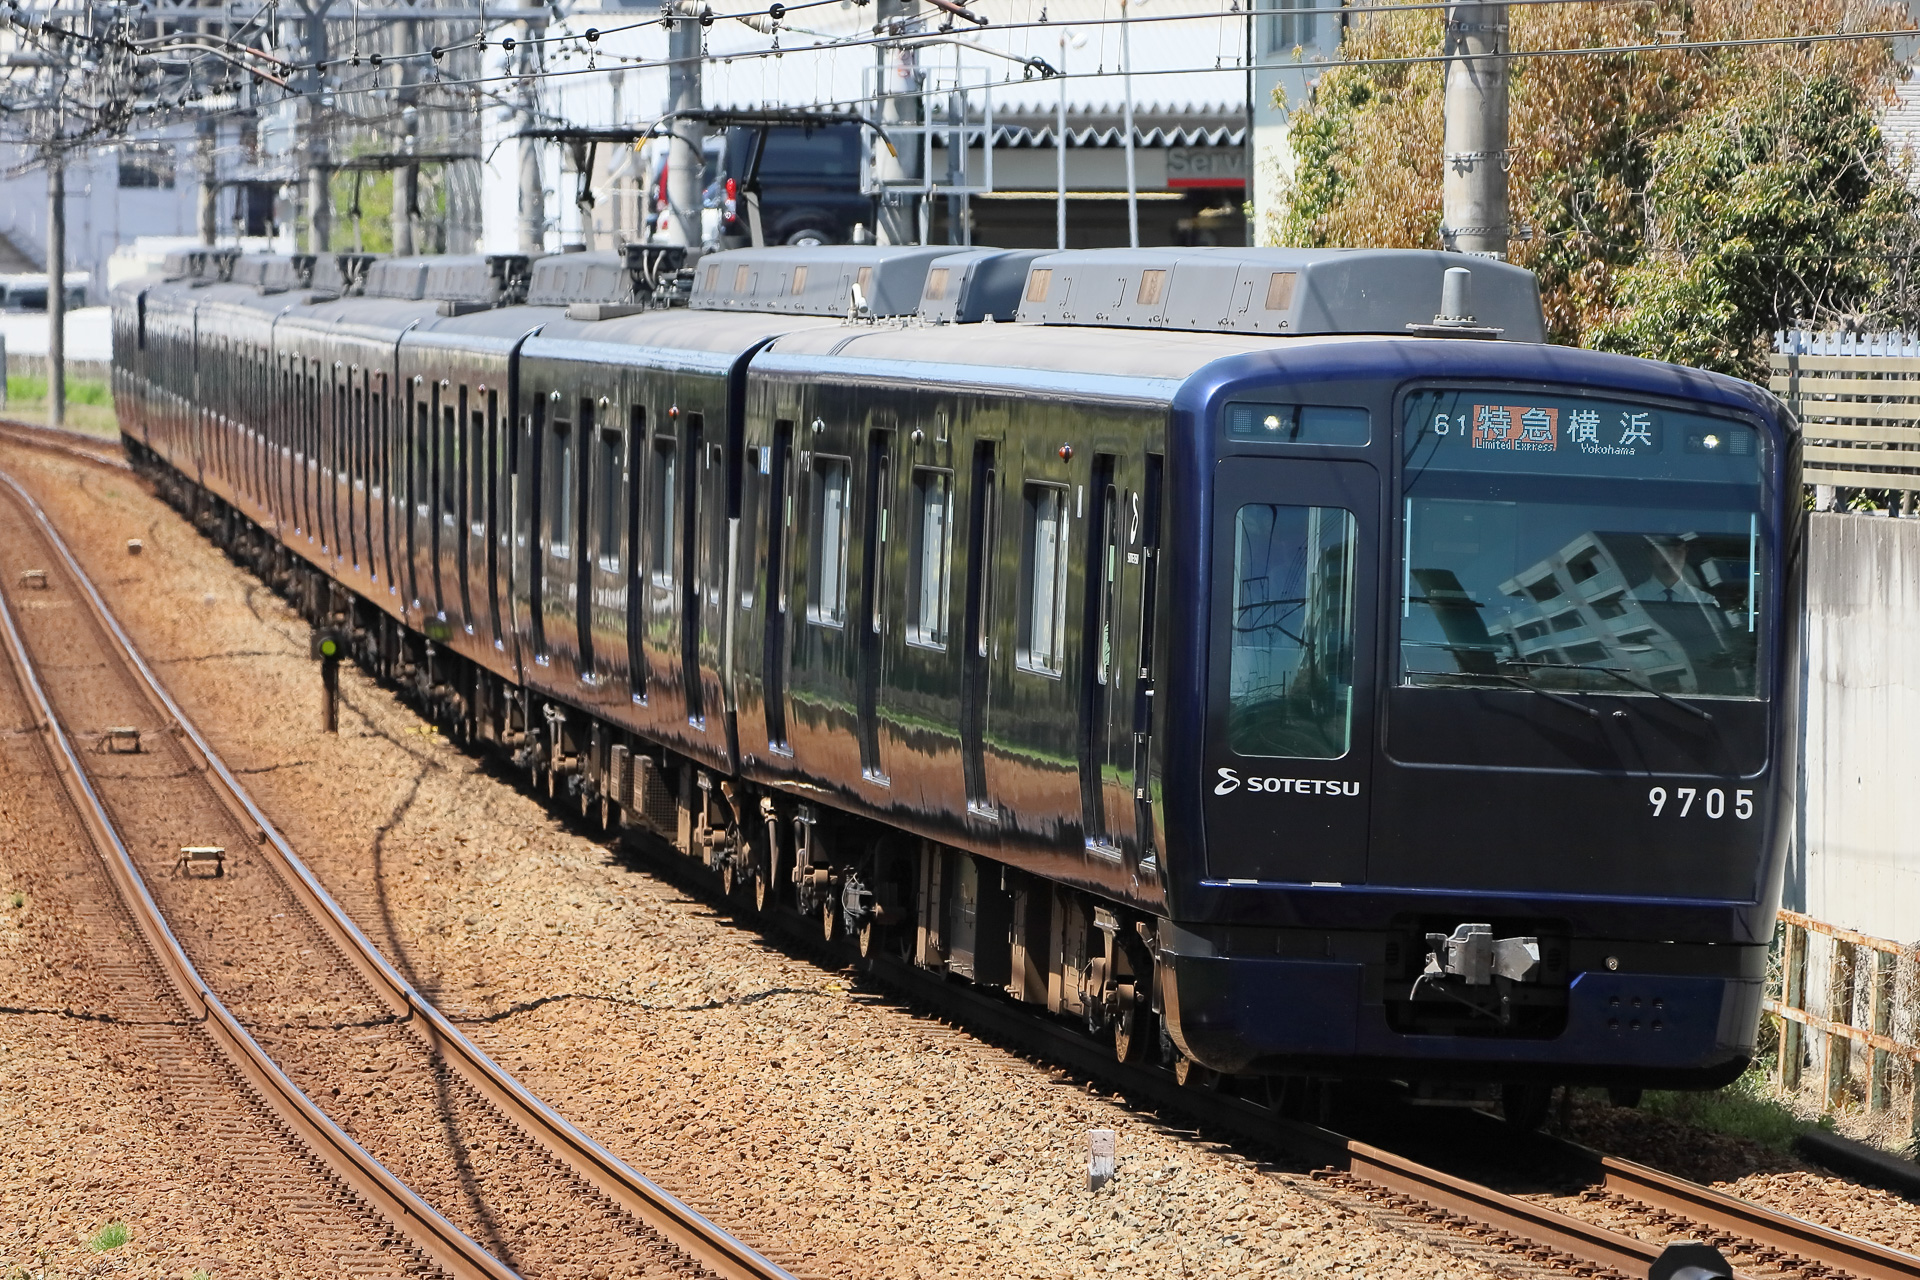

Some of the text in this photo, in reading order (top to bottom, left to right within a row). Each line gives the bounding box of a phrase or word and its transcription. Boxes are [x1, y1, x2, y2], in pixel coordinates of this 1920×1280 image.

[1434, 413, 1466, 436] 61
[1478, 405, 1553, 441] 特急
[1566, 409, 1652, 446] 横浜
[1476, 438, 1554, 452] Limited Express
[1580, 443, 1636, 456] Yokohama
[1247, 777, 1360, 796] SOTETSU
[1648, 786, 1754, 820] 9705
